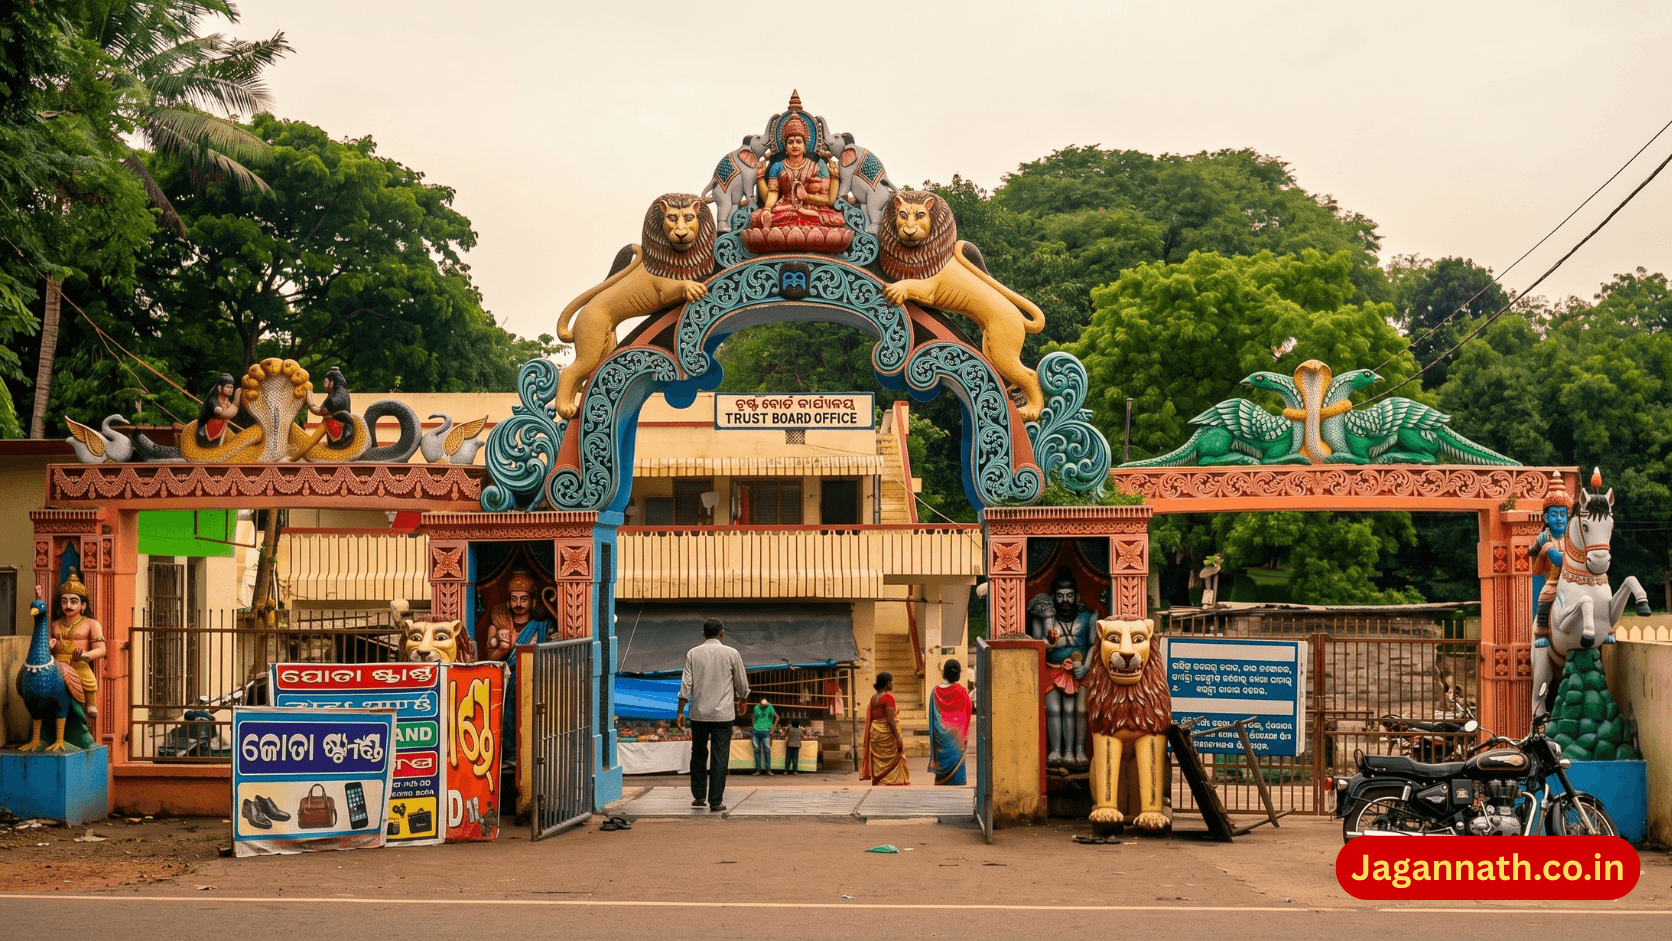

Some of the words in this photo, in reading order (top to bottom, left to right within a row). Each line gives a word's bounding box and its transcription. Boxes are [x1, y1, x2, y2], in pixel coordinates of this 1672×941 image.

[725, 413, 769, 424] TRUST
[772, 413, 812, 424] BOARD
[814, 413, 858, 424] OFFICE
